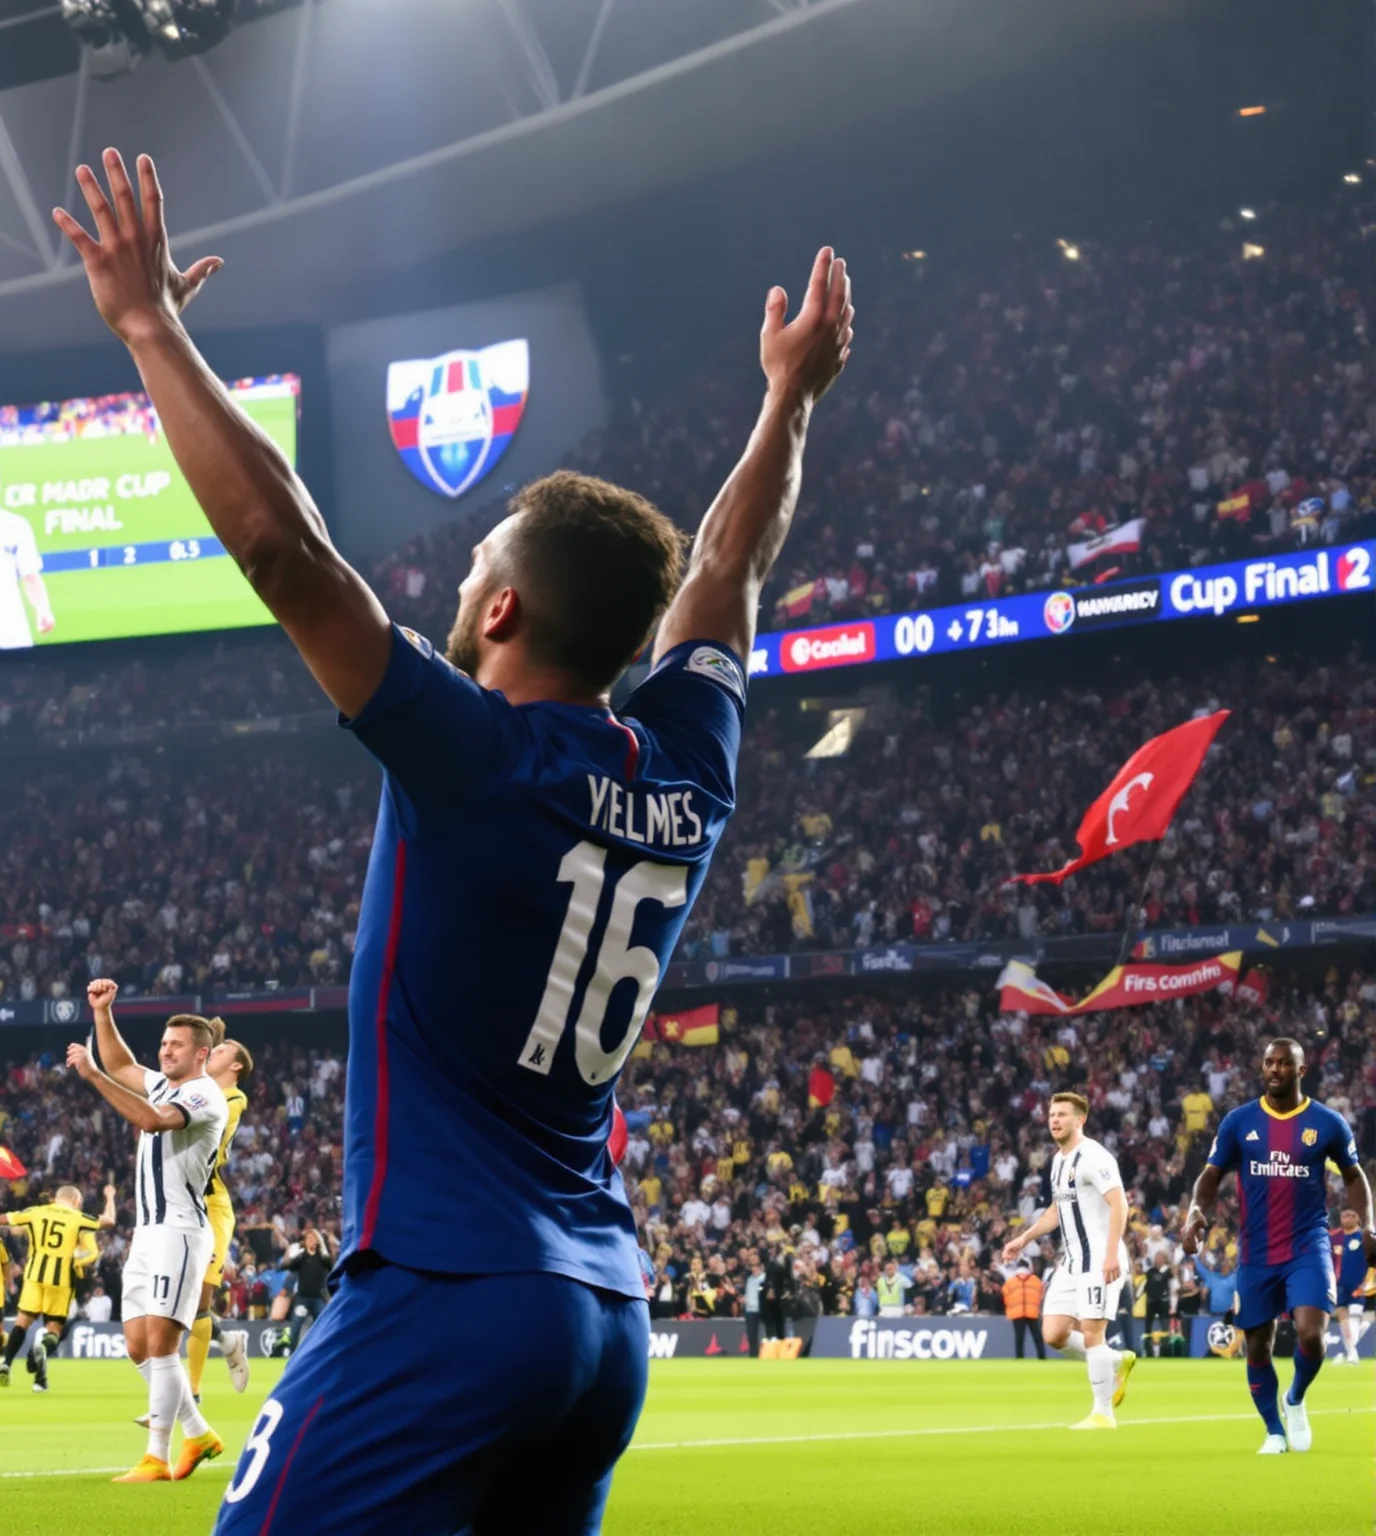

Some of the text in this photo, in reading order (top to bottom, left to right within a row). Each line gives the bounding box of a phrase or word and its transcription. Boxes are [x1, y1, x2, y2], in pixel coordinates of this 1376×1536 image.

[115, 470, 171, 499] CUP
[44, 504, 123, 535] FINAL
[124, 546, 136, 564] 2
[1170, 547, 1371, 615] Cup Final 2
[587, 773, 702, 845] YELMES
[516, 839, 689, 1086] 16
[40, 1217, 67, 1250] 15
[849, 1319, 988, 1360] finscow
